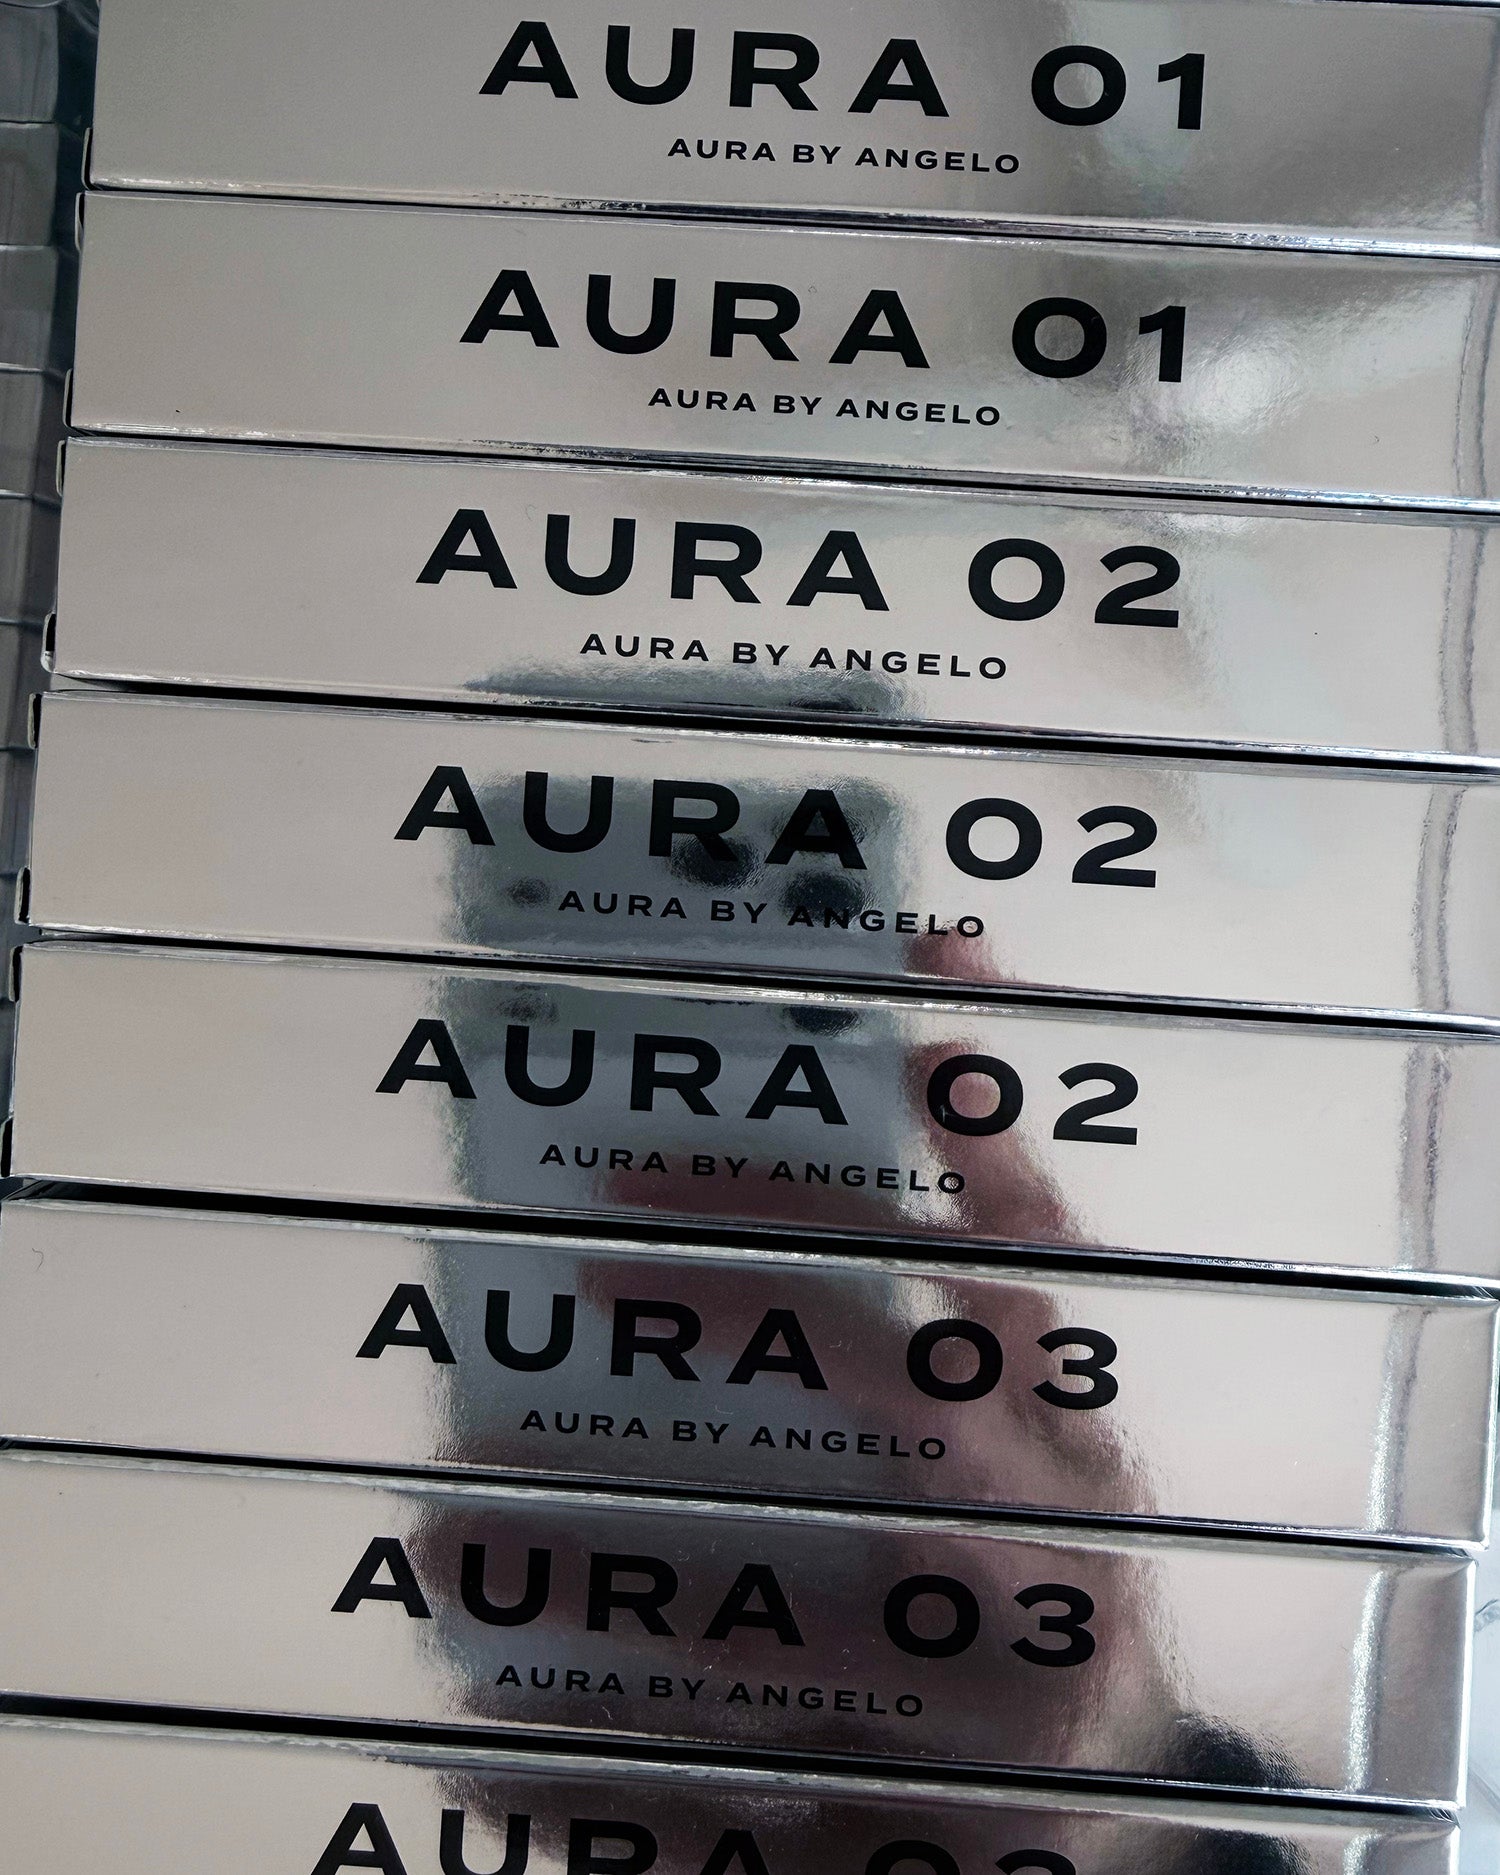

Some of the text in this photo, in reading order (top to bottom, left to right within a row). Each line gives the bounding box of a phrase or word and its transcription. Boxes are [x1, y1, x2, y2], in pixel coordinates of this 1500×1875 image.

[479, 21, 949, 117] AURA
[668, 139, 1019, 174] AURA BY ANGELO
[460, 269, 930, 368] AURA
[648, 388, 999, 425] AURA BY ANGELO
[416, 509, 889, 611] AURA
[580, 634, 1006, 679] AURA BY ANGELO
[394, 766, 866, 870] AURA
[558, 891, 984, 939] AURA BY ANGELO
[376, 1018, 848, 1125] AURA
[539, 1144, 966, 1194] AURA BY ANGELO
[356, 1284, 828, 1390] AURA
[520, 1410, 946, 1459] AURA BY ANGELO
[330, 1537, 805, 1646] AURA
[495, 1665, 923, 1718] AURA BY ANGELO
